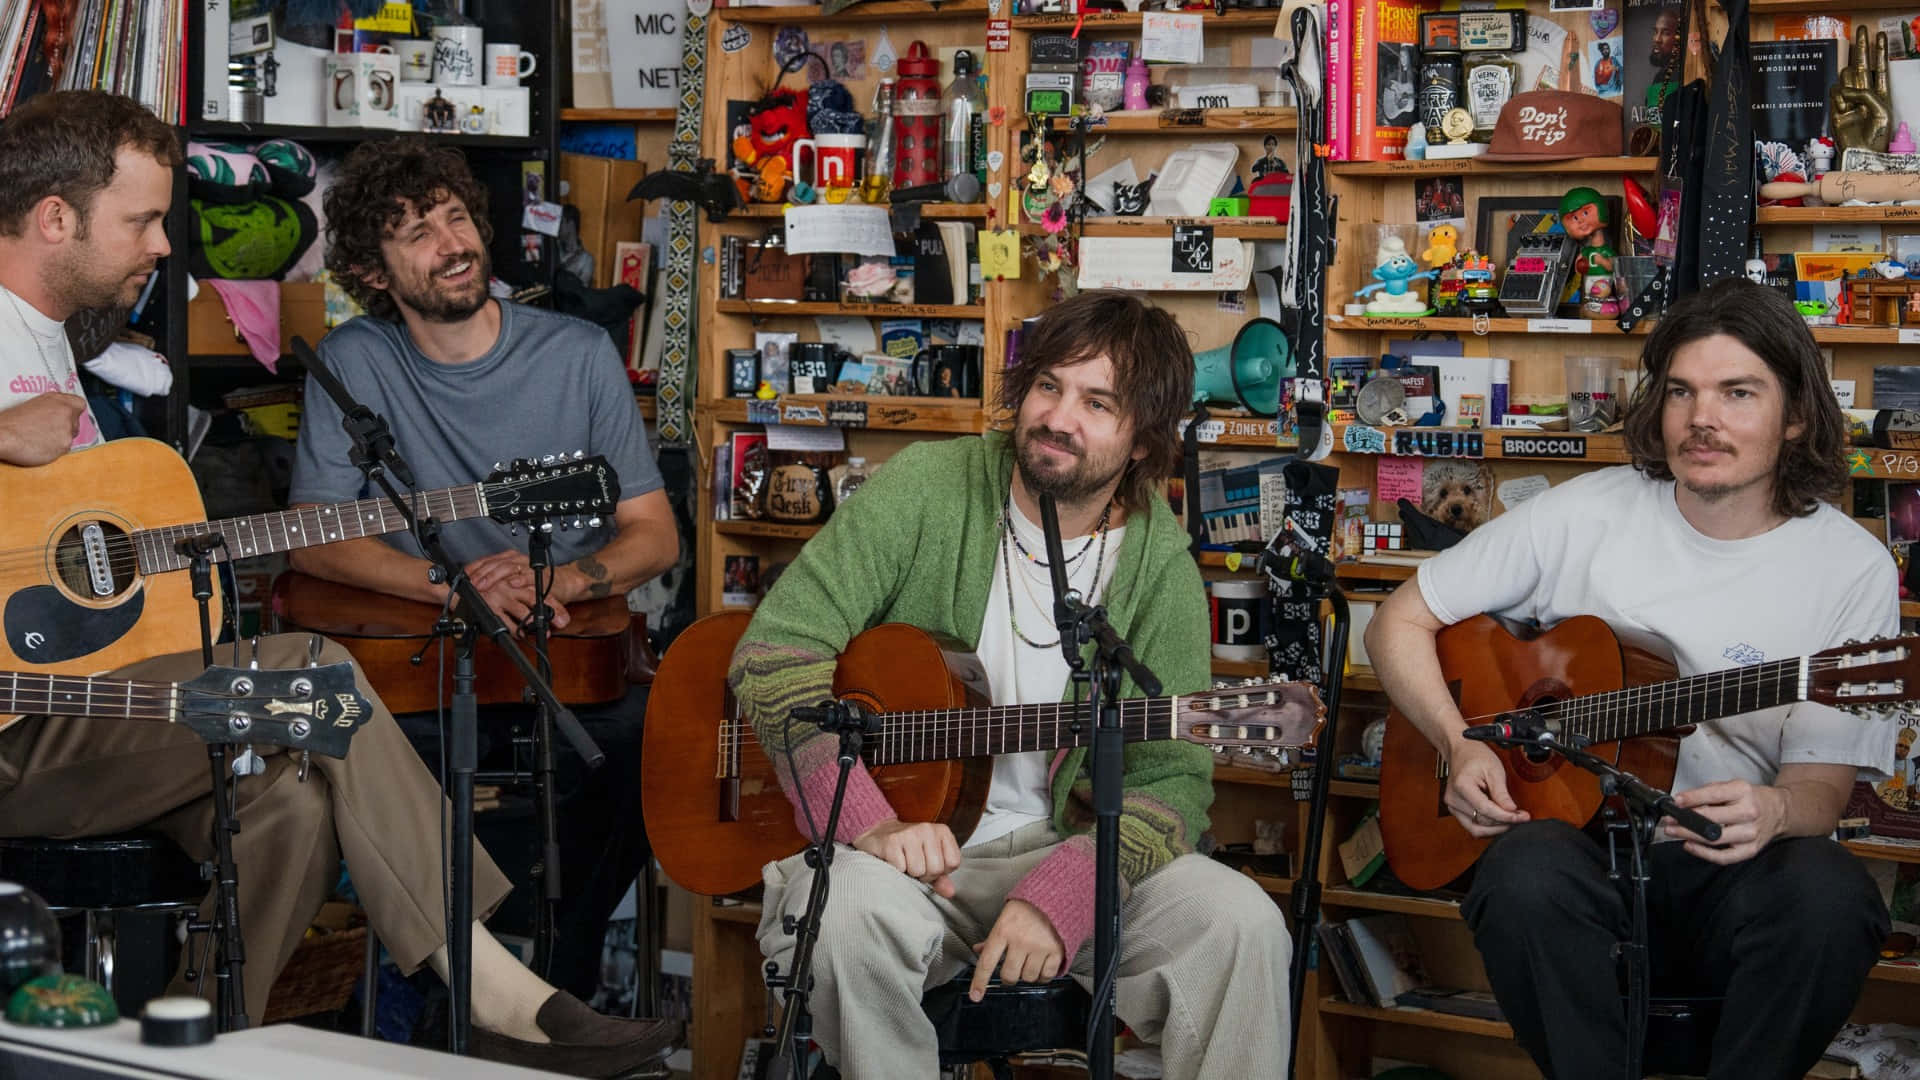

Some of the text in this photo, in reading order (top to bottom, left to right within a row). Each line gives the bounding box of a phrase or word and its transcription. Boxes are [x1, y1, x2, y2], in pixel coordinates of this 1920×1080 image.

[635, 13, 676, 35] MIC
[1753, 53, 1782, 61] HUNGER
[1812, 51, 1823, 59] ME
[639, 67, 681, 89] NET
[1519, 106, 1568, 129] Don't
[1523, 126, 1566, 146] Trip
[1229, 421, 1265, 436] ZONEY
[1504, 439, 1584, 455] BROCCOLI
[1226, 607, 1251, 644] p
[332, 693, 362, 728] GUILD
